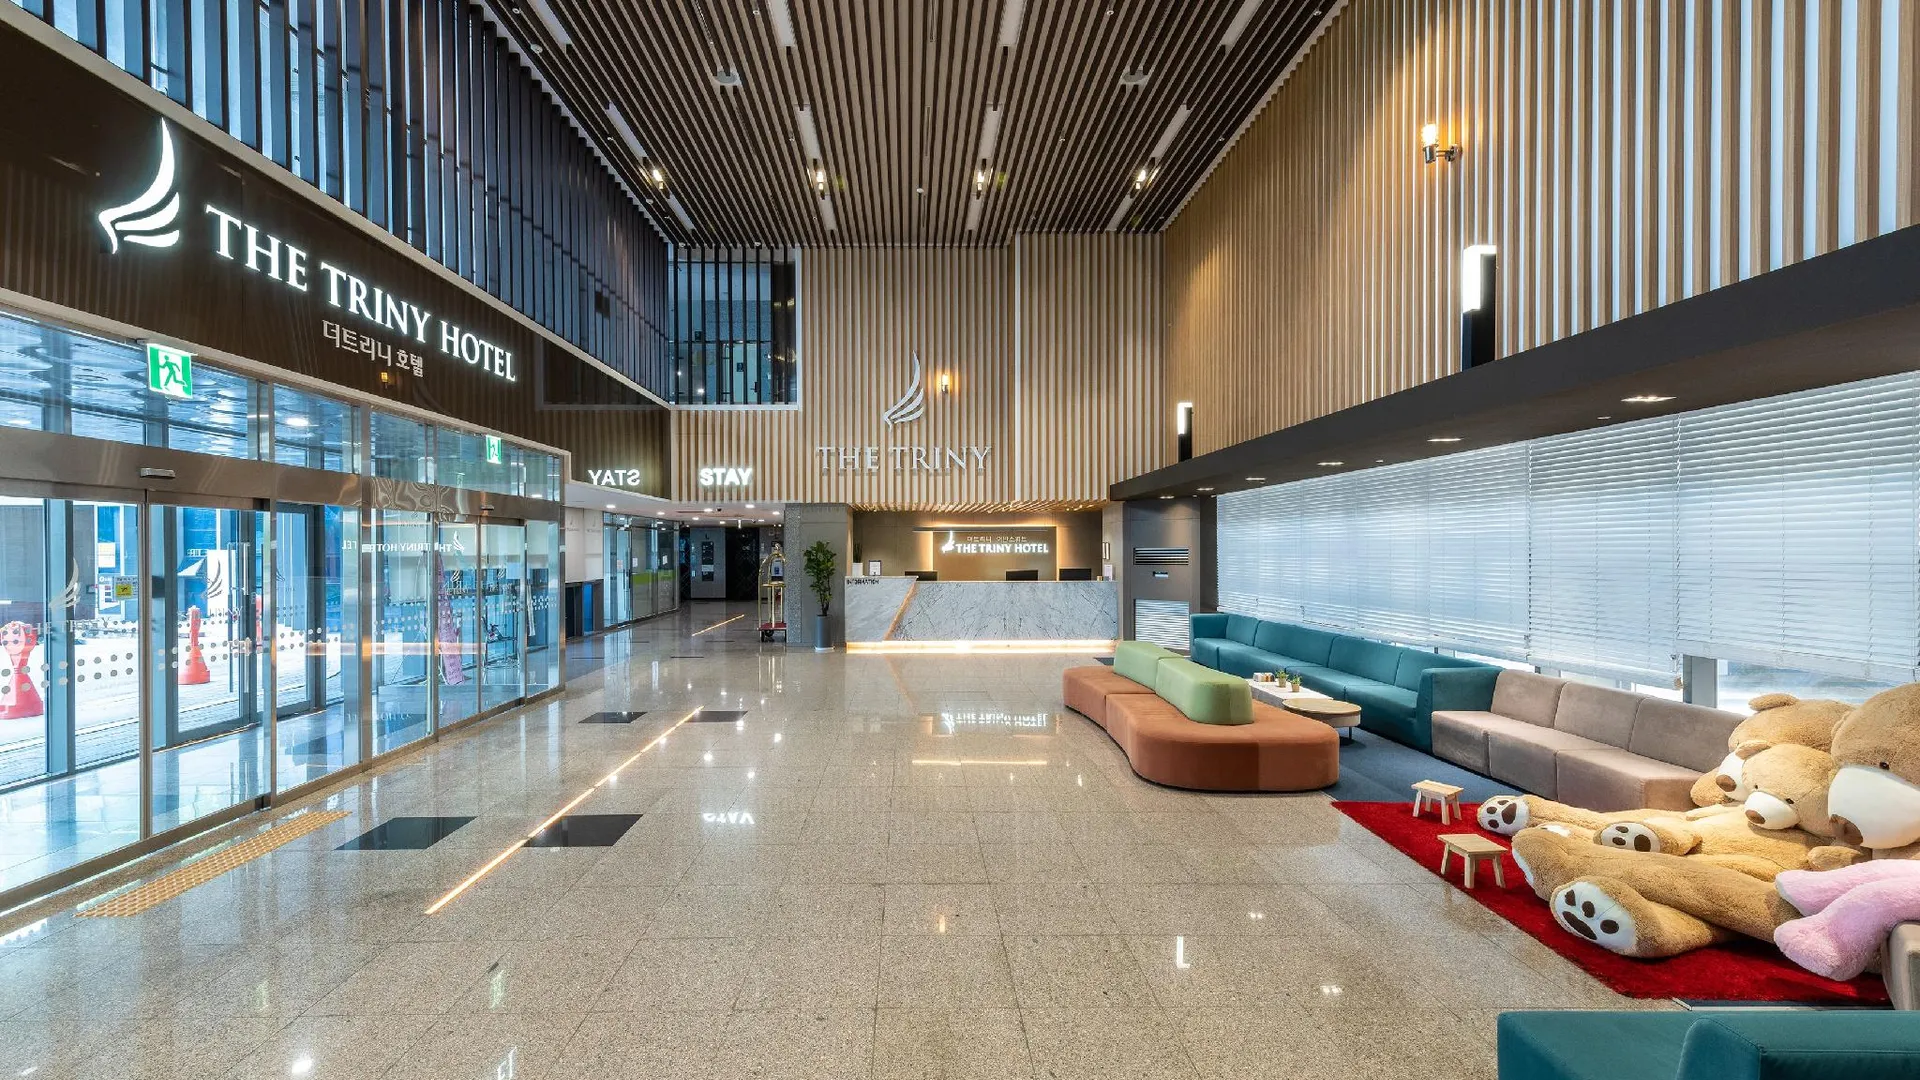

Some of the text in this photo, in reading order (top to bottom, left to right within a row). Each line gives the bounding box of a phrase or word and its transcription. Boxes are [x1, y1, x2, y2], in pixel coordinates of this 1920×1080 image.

[205, 204, 516, 382] THE TRINY HOTEL
[322, 319, 424, 378] 더트리니 호텔
[818, 446, 992, 471] THE TRINY
[699, 467, 753, 486] STAY
[956, 543, 1049, 553] THE TRINY HOTEL
